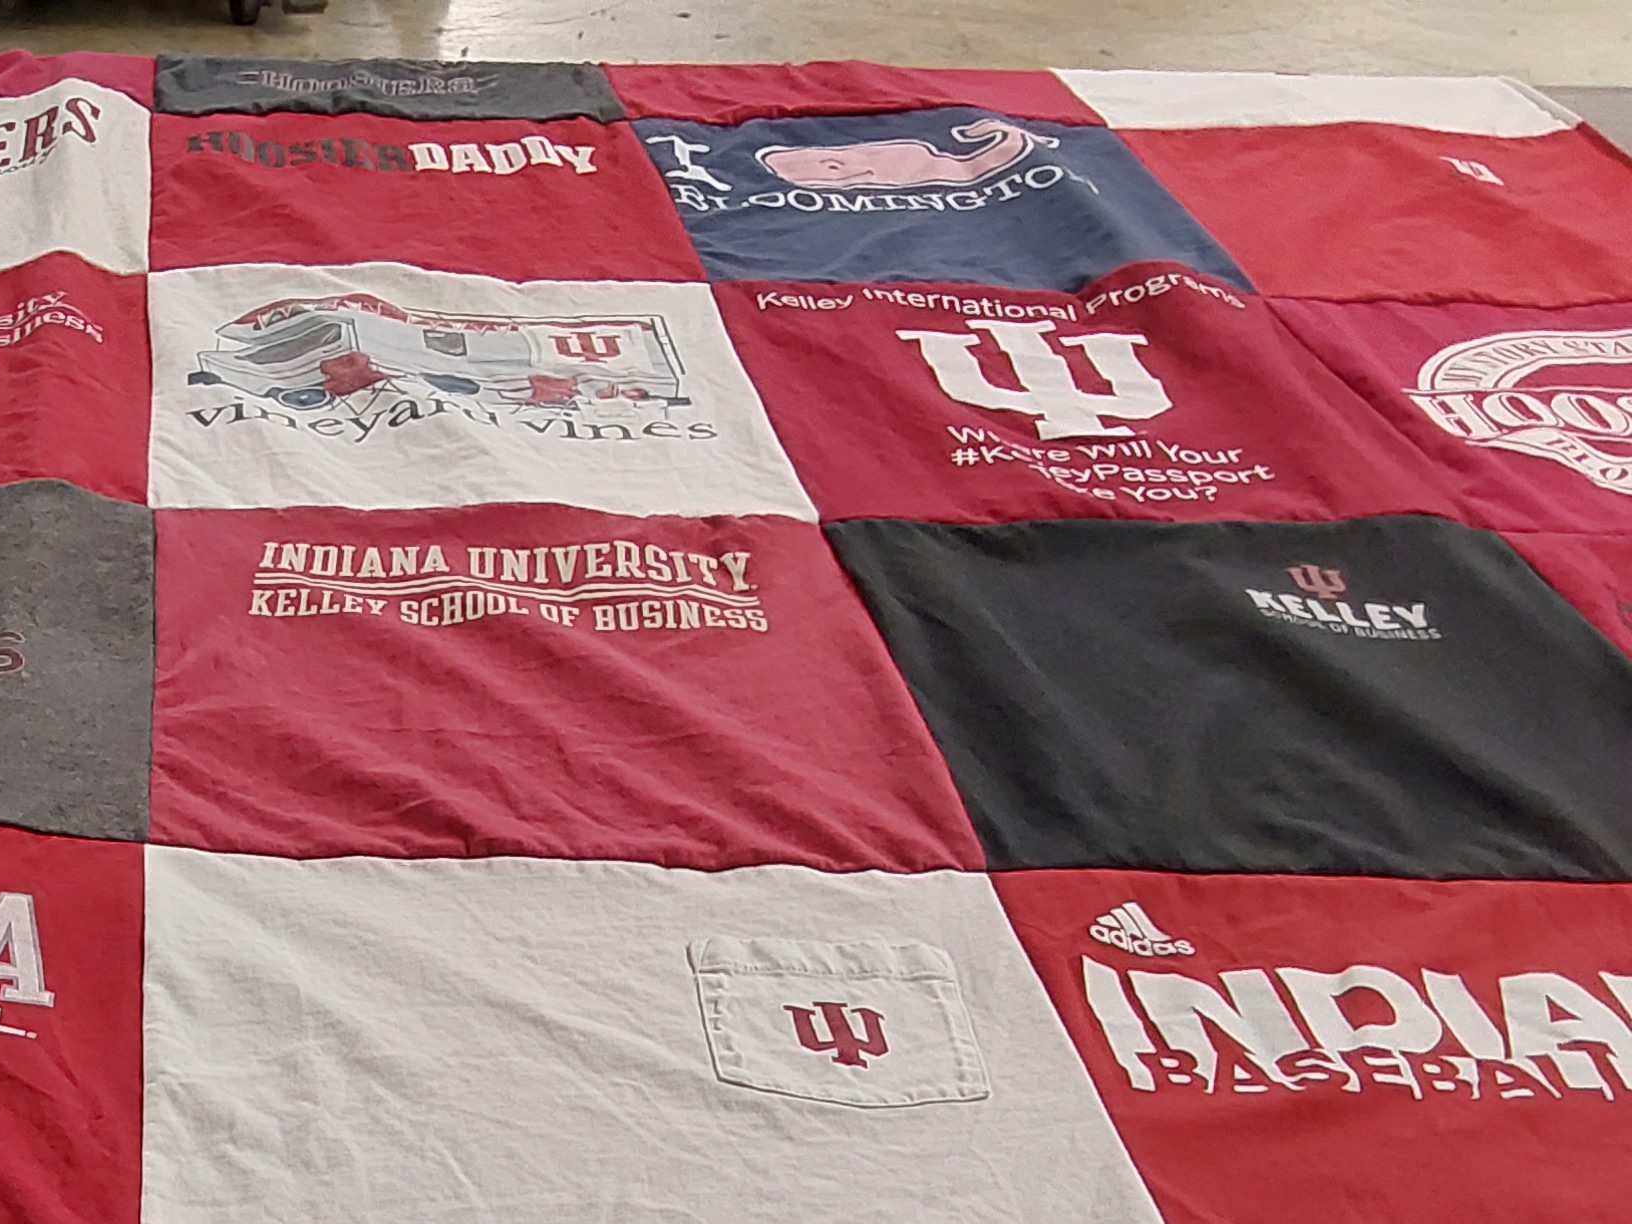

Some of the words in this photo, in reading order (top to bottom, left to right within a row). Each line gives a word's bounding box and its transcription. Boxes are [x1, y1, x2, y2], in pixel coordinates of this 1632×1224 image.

[186, 130, 411, 171] HOOSIER
[408, 134, 598, 176] DADDY
[756, 290, 855, 312] Kelley
[861, 286, 1077, 323] International
[1085, 272, 1247, 316] Programs
[520, 413, 718, 443] vines
[1075, 438, 1154, 461] Will
[1156, 438, 1244, 465] Your
[1120, 485, 1219, 502] You?
[258, 540, 450, 579] INDIANA
[248, 588, 385, 619] KELLEY
[400, 590, 530, 628] SCHOOL
[540, 603, 581, 628] OF
[593, 598, 770, 634] BUSINESS
[1245, 588, 1429, 631] KELLEY
[1354, 625, 1443, 641] BUSINESS
[1089, 923, 1196, 957] adidas
